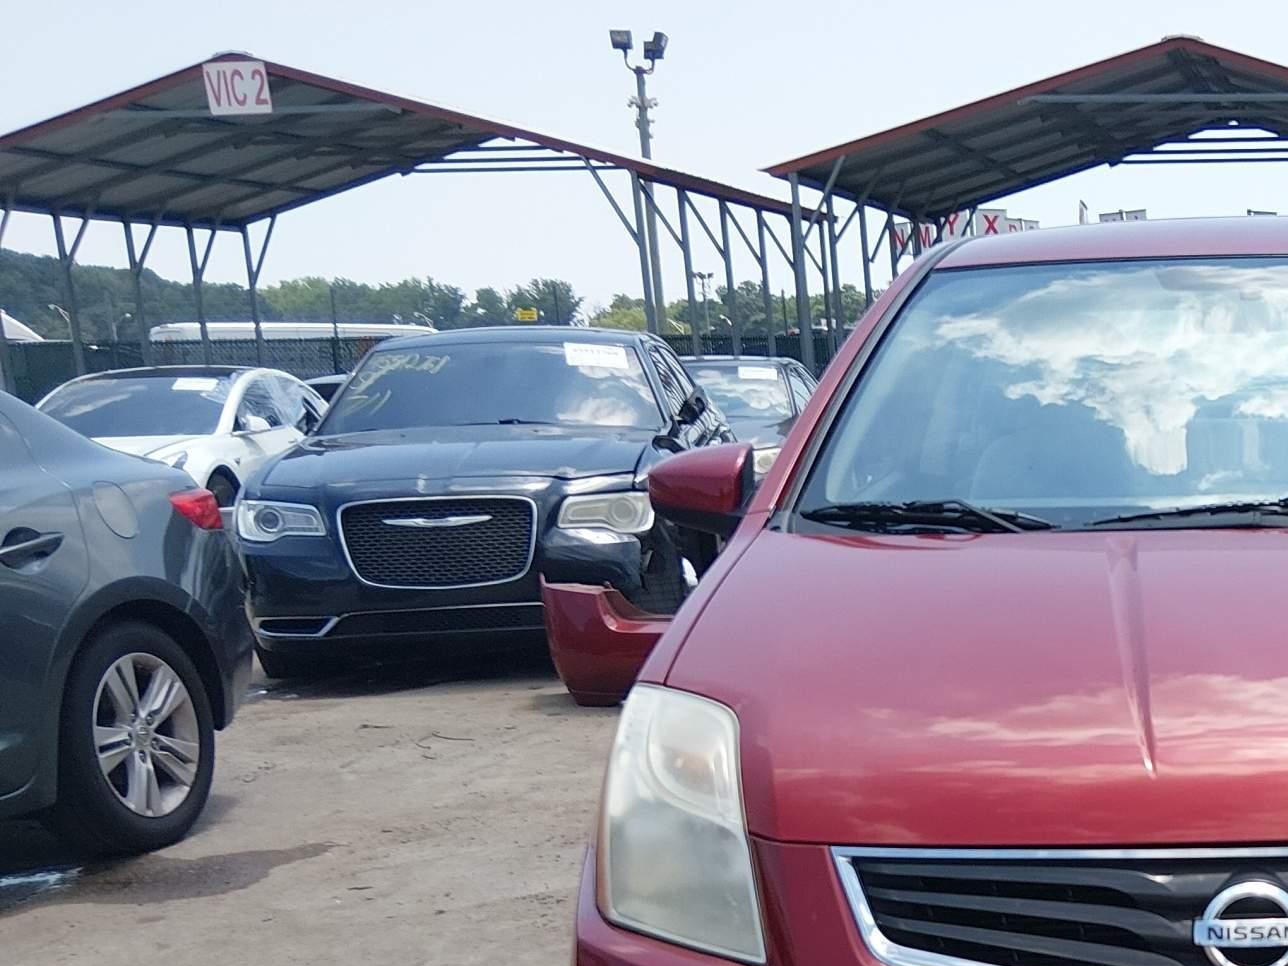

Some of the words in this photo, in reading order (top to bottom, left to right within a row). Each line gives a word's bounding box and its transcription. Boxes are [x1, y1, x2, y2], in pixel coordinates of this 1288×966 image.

[205, 68, 247, 107] VIC
[251, 68, 269, 106] 2
[947, 212, 960, 236] Y
[983, 214, 1000, 235] X
